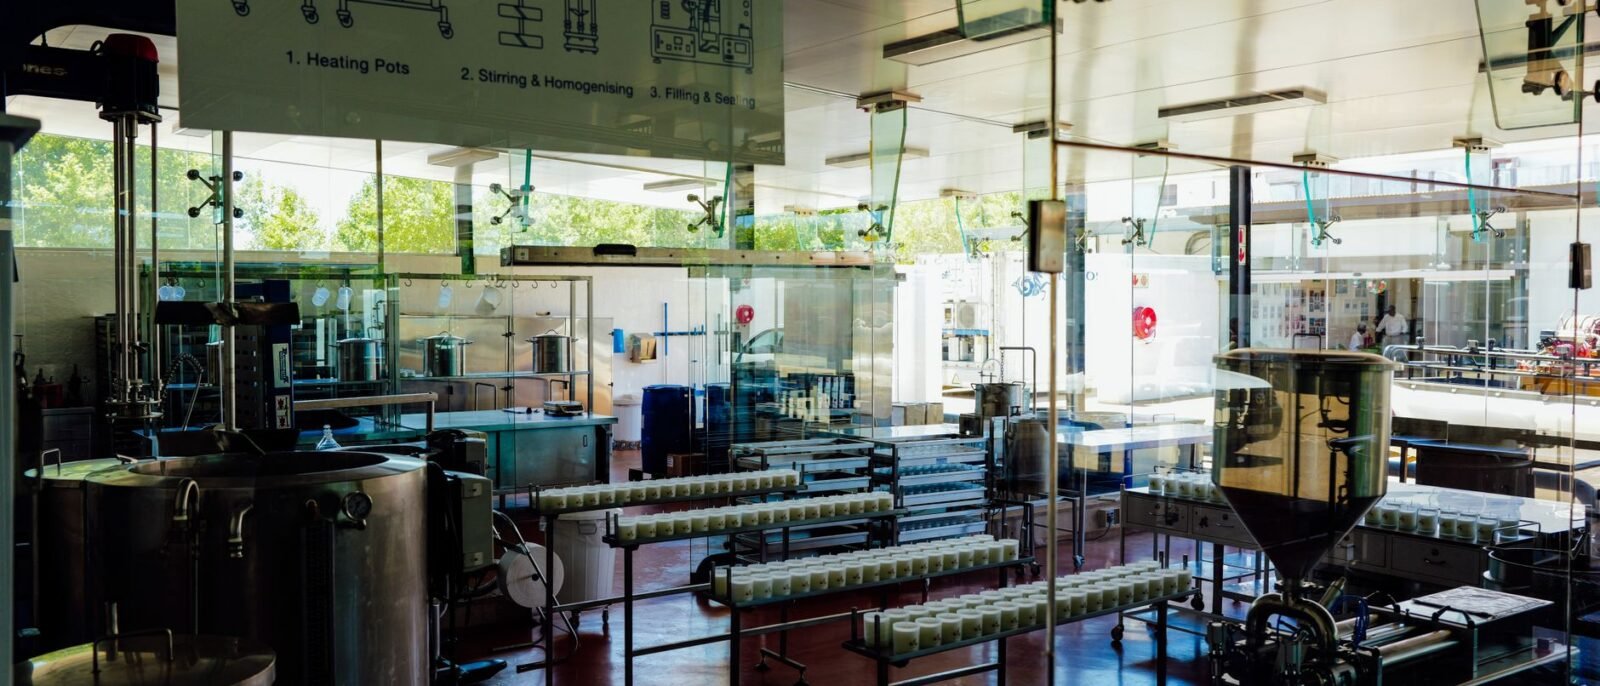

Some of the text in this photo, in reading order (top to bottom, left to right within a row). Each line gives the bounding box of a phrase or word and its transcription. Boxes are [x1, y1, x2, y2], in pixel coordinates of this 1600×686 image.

[286, 50, 410, 75] 1. Heating Pots
[460, 67, 634, 98] 2. Stirring & Homogenising
[650, 86, 661, 98] 3.
[665, 87, 700, 105] Filling
[703, 91, 711, 103] &
